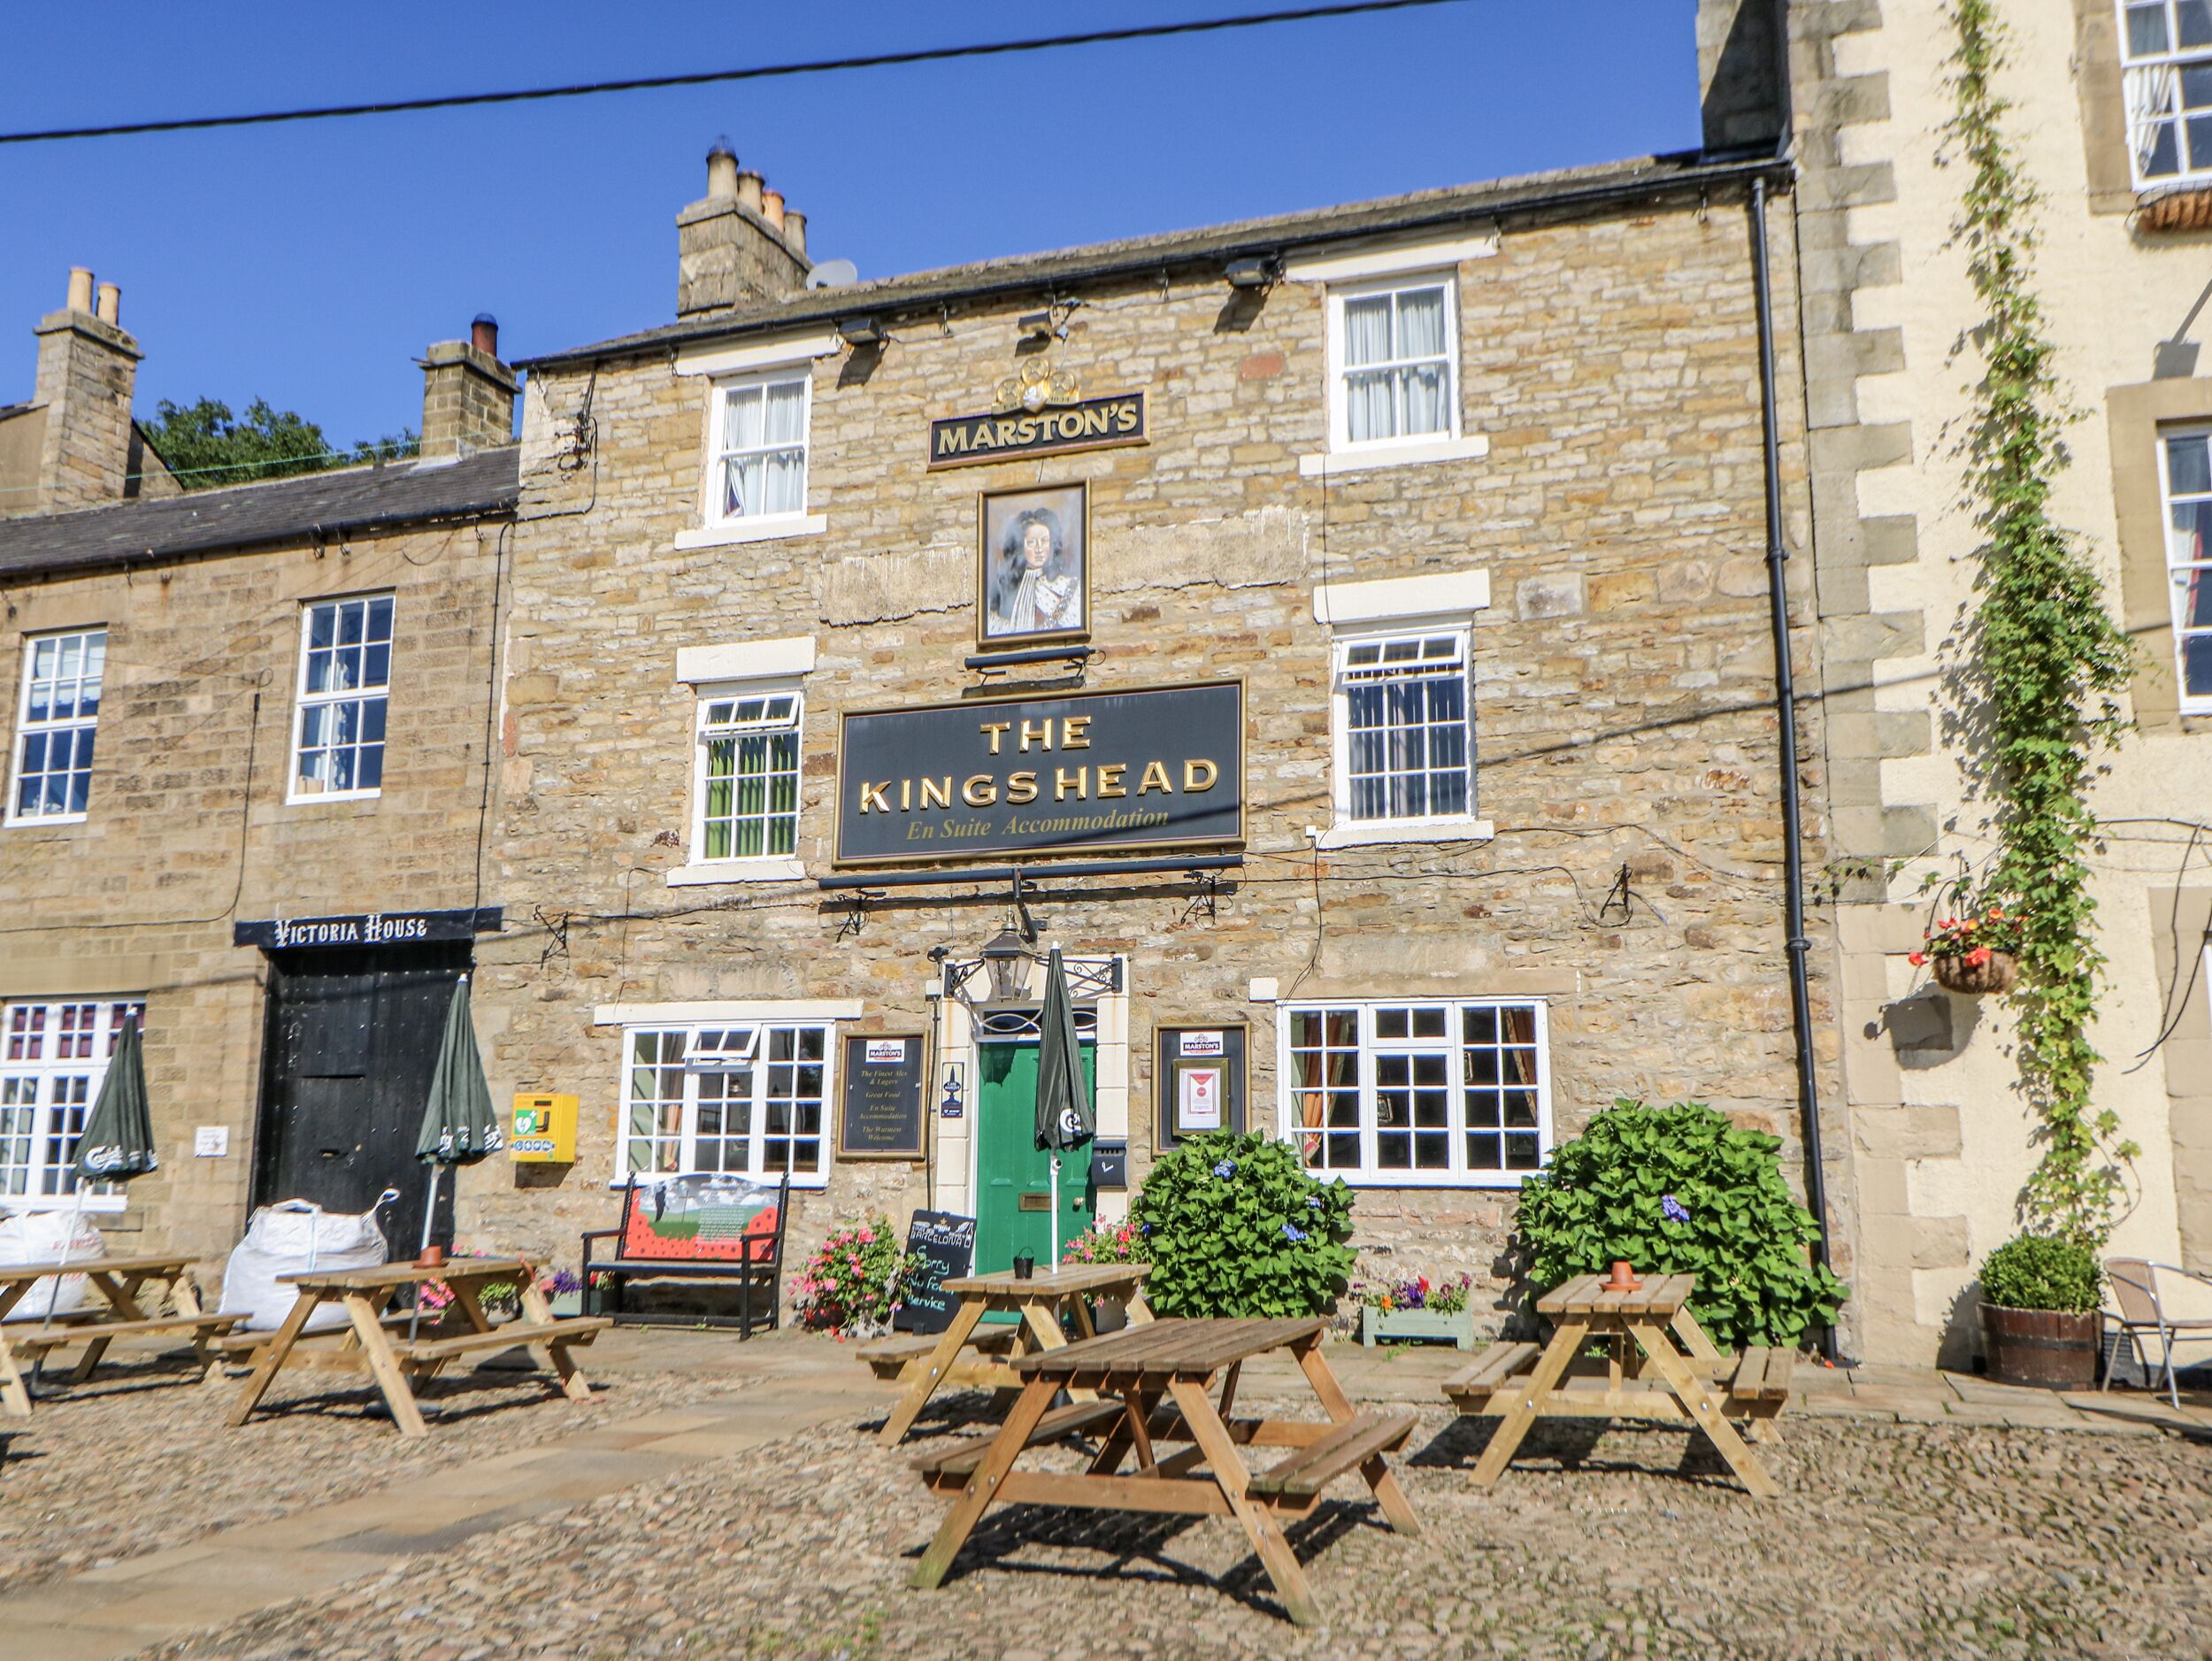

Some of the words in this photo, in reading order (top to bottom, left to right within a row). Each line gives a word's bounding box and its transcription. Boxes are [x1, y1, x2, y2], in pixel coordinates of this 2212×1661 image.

[937, 403, 1138, 456] MARSTON'S
[979, 715, 1092, 755] THE
[859, 770, 1040, 814] KINGS
[1054, 758, 1218, 802] HEAD
[906, 820, 934, 842] En
[940, 816, 992, 840] Suite
[1002, 807, 1170, 837] Accommodation
[910, 1231, 962, 1248] BARCELONA
